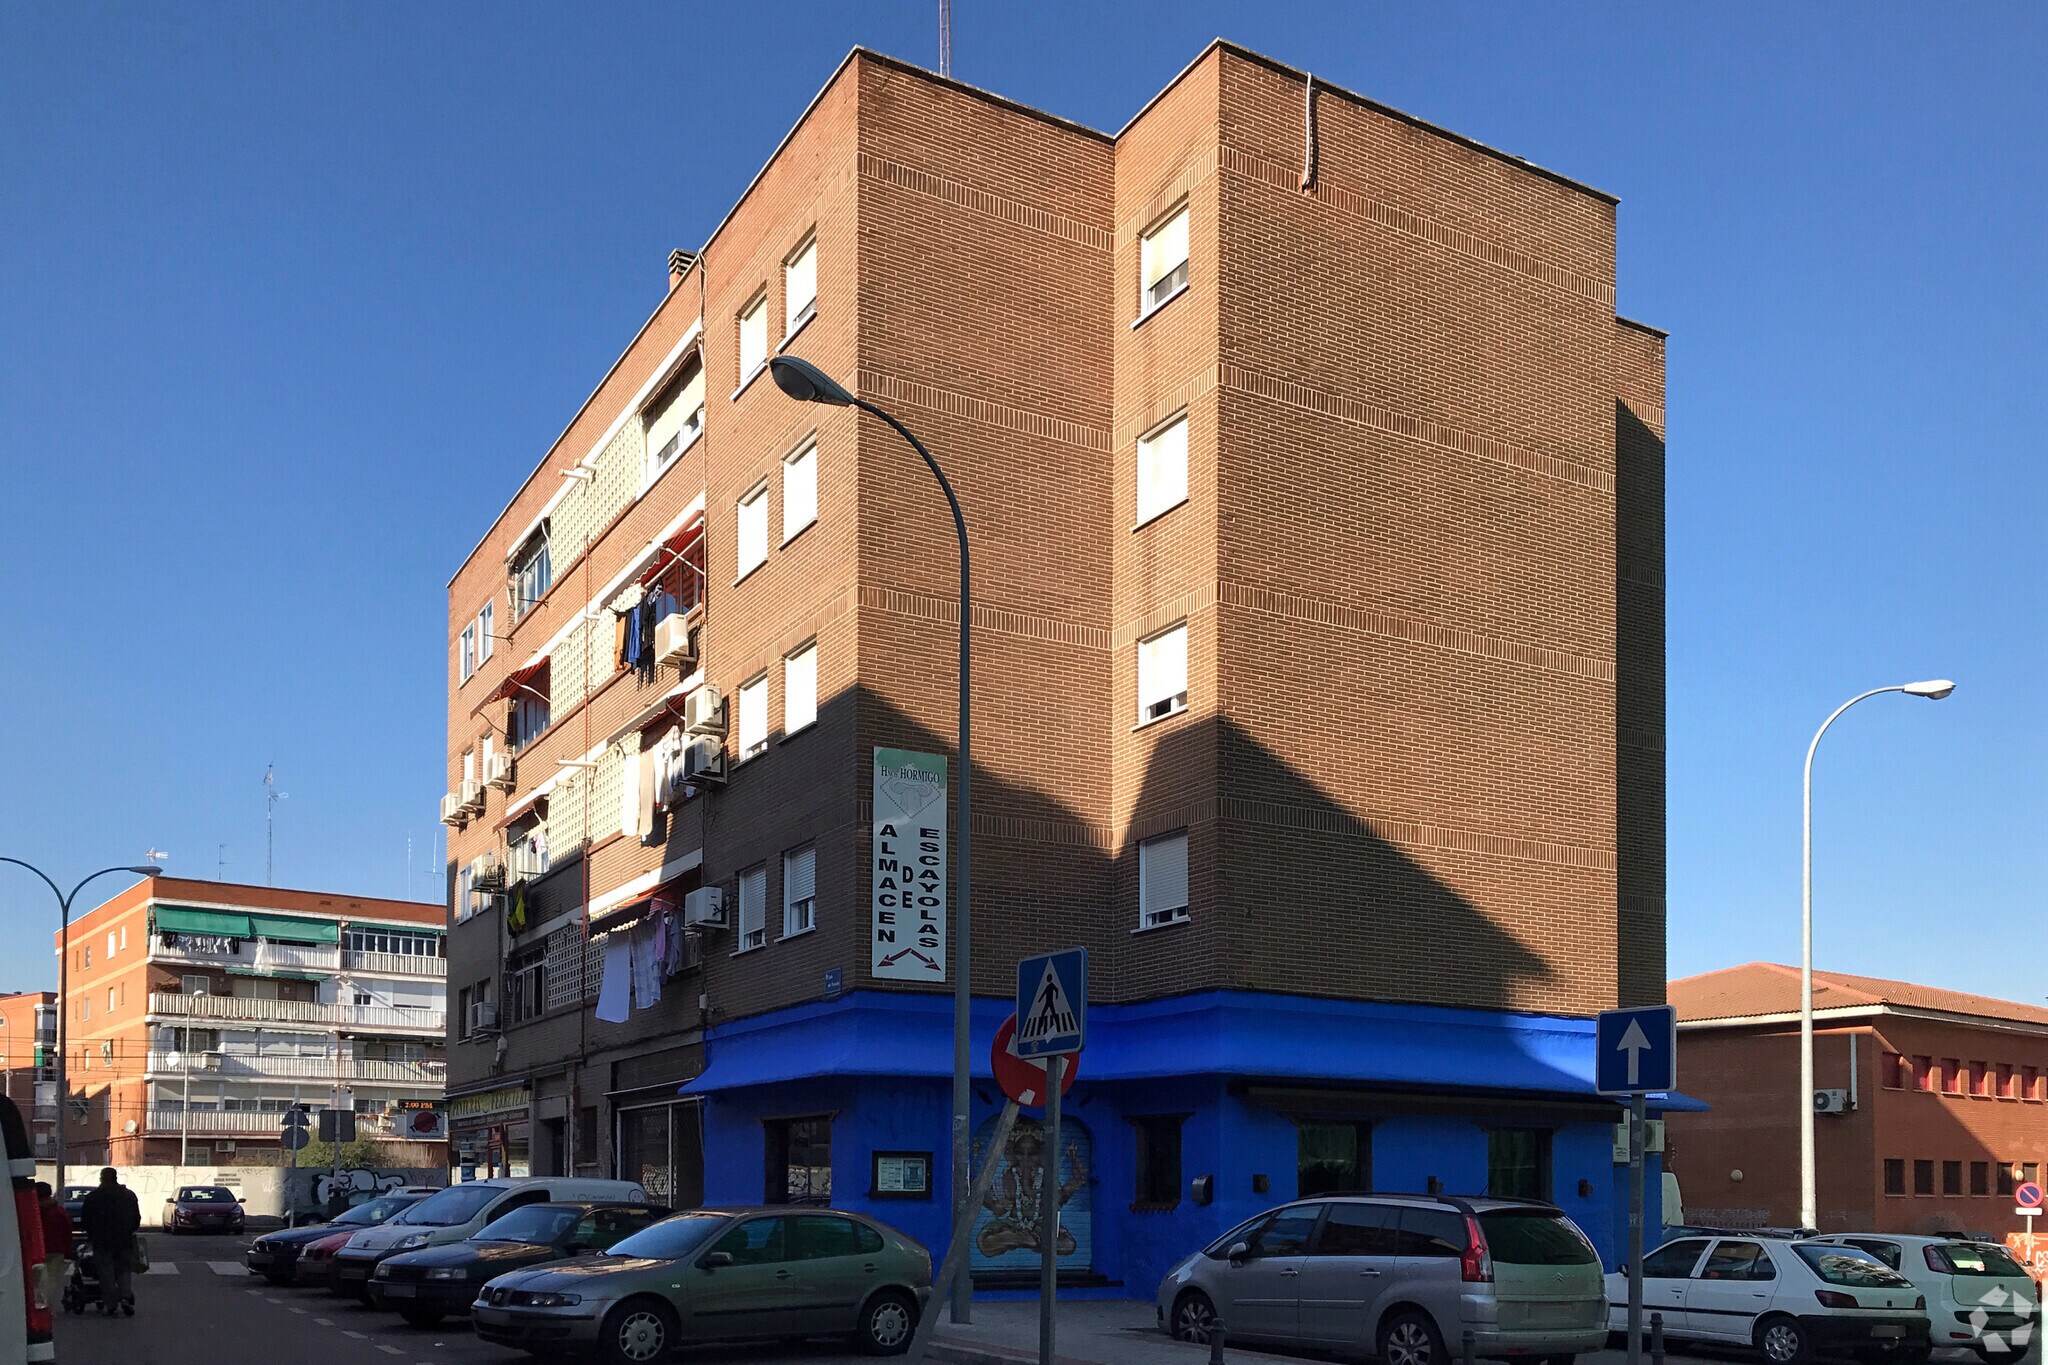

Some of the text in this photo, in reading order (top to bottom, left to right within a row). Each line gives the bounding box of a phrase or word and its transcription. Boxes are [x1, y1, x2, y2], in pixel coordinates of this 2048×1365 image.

[900, 768, 940, 783] HORMIGO
[878, 824, 898, 943] ALMACEN
[902, 865, 914, 909] DE
[917, 827, 941, 948] ESCAYOLAS
